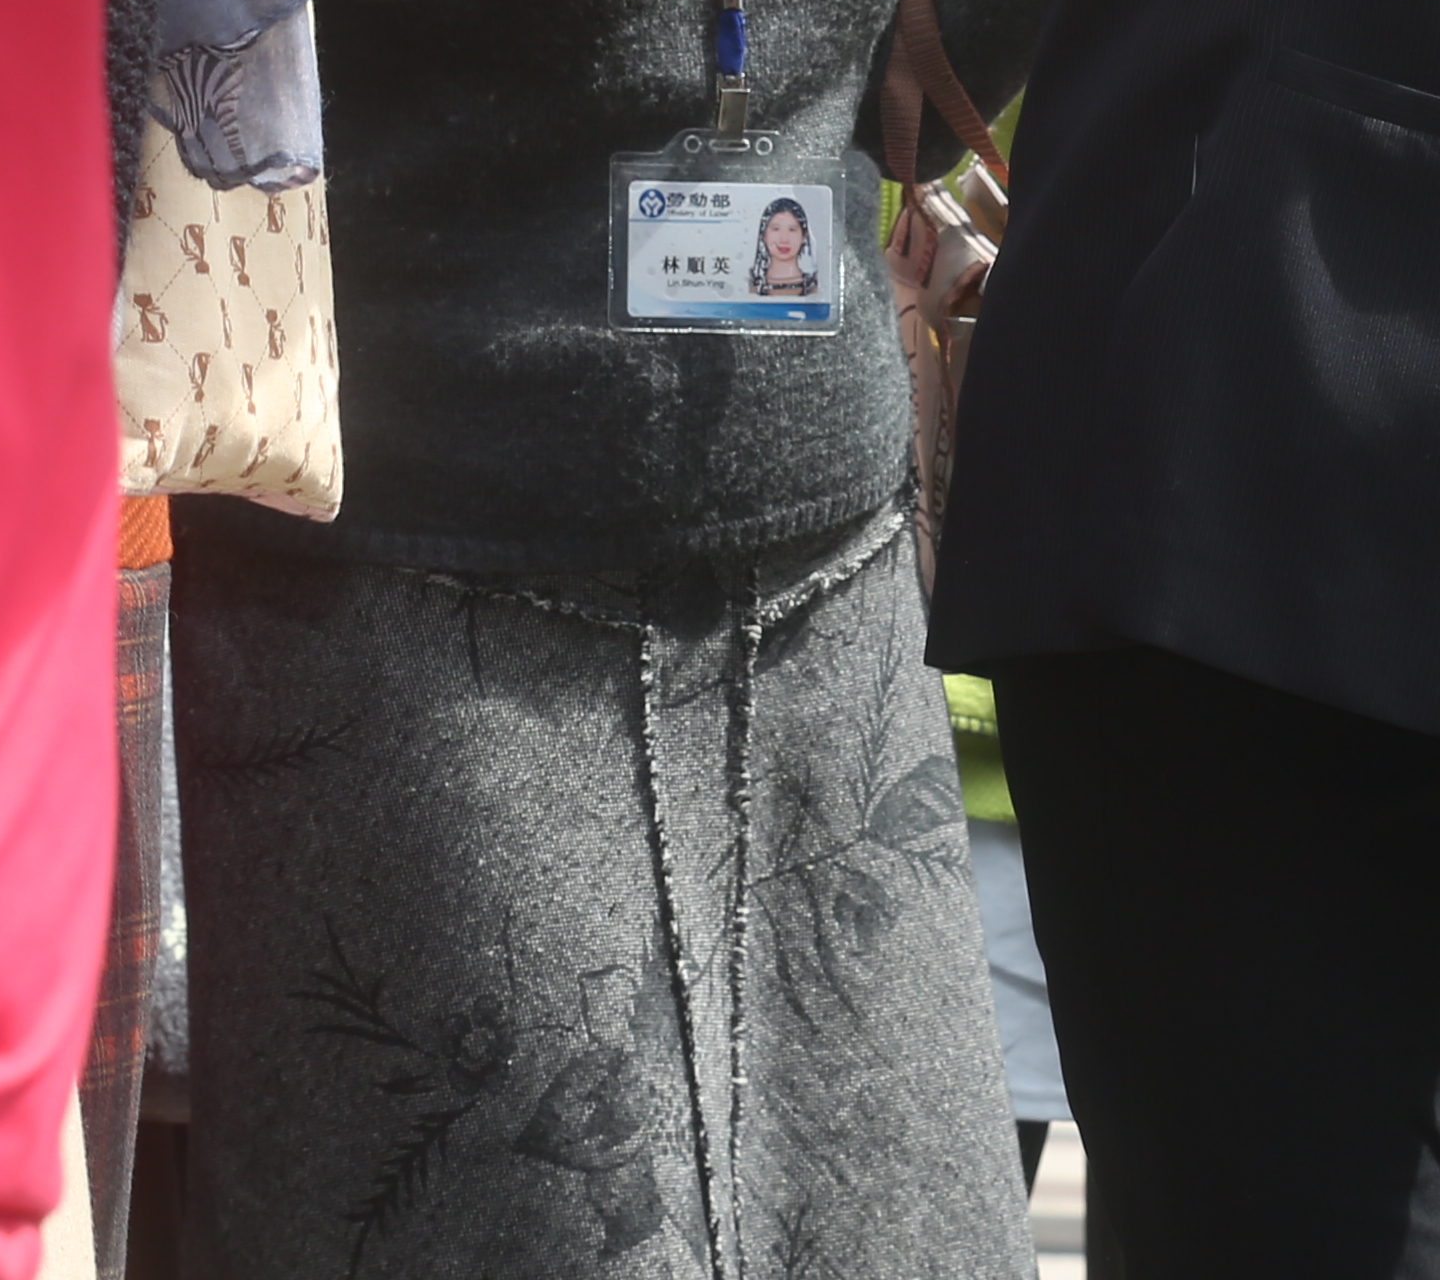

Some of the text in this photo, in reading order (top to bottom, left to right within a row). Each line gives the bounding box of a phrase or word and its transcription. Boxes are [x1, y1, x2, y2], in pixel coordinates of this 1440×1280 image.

[666, 191, 731, 209] 勞動部
[662, 254, 731, 276] 林順英
